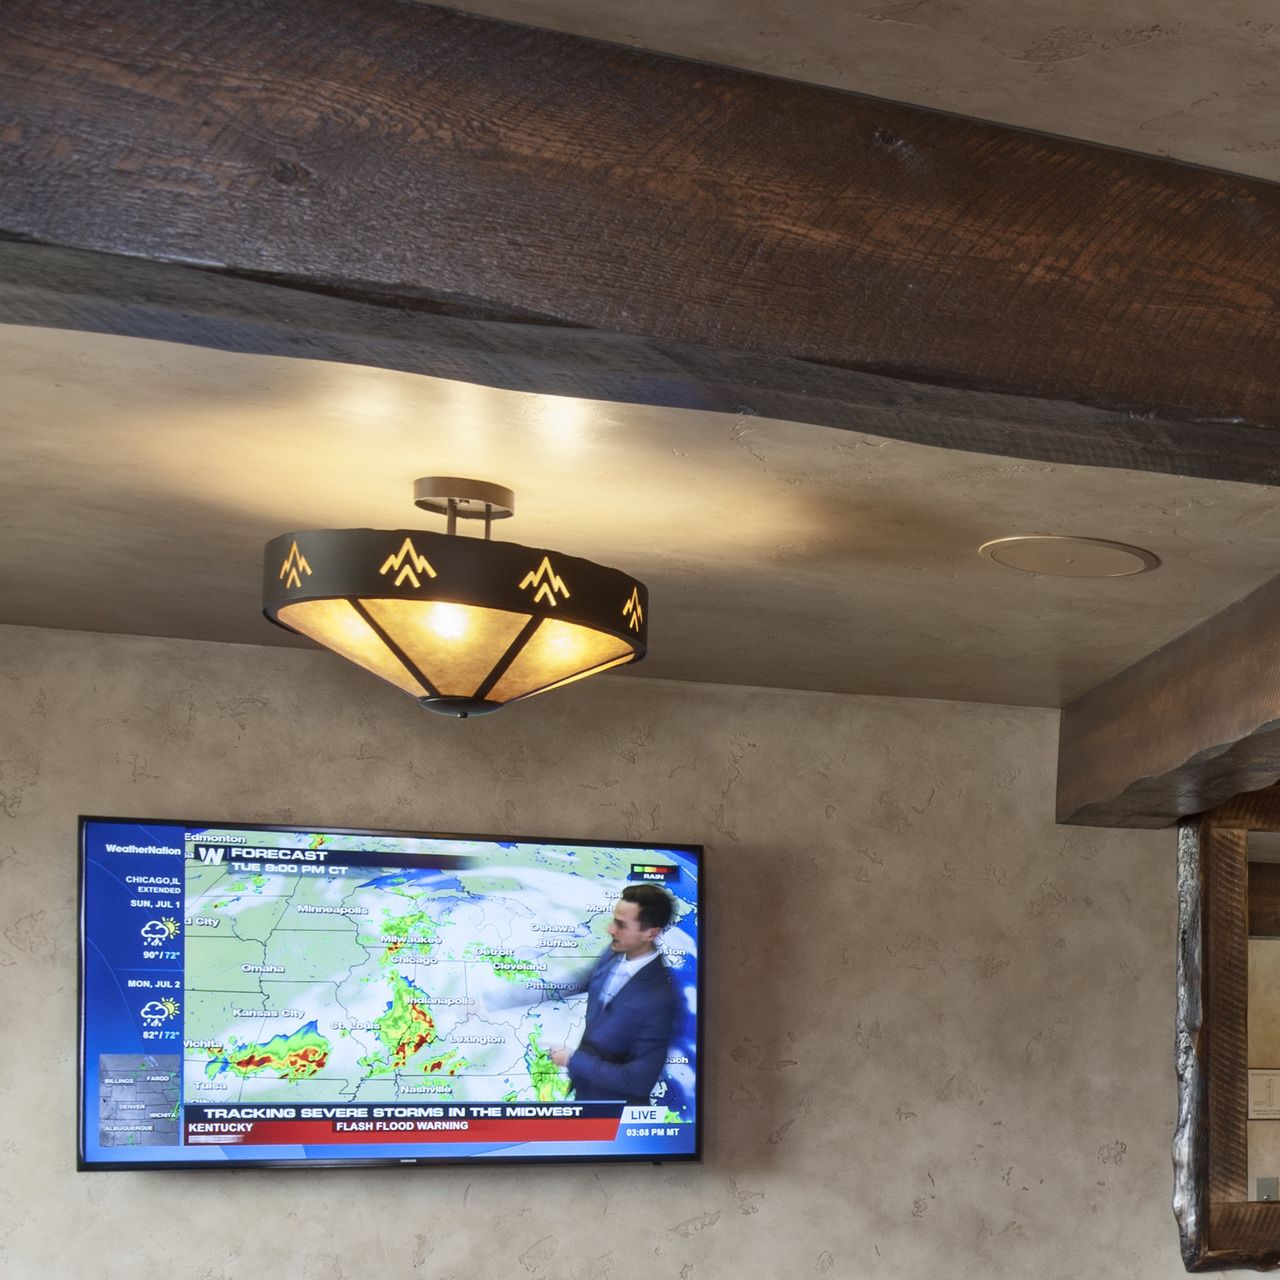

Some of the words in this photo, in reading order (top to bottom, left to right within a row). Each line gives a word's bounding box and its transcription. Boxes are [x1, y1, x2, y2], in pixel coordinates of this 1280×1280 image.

[185, 833, 246, 843] Edmonton
[105, 843, 181, 855] WeatherNation
[231, 847, 328, 861] FORECAST
[231, 862, 261, 872] TUE
[265, 864, 297, 873] 9:00
[301, 865, 325, 874] PM
[328, 866, 348, 875] CT
[138, 886, 181, 894] EXTENDED
[130, 899, 153, 908] SUN,
[155, 900, 173, 908] JUL
[586, 904, 616, 912] Mont
[297, 904, 369, 915] Minneapolis
[195, 918, 219, 927] City
[381, 935, 442, 945] Milwaukee
[539, 939, 578, 948] Buffalo
[475, 947, 514, 956] Detroit
[391, 955, 438, 966] Chicago
[241, 964, 285, 973] Omaha
[493, 962, 547, 971] Cleveland
[128, 980, 152, 988] MON,
[155, 980, 173, 988] JUL
[233, 1008, 278, 1017] Kansas
[281, 1008, 305, 1019] City
[193, 1081, 227, 1090] Tulsa
[400, 1085, 452, 1093] Nashville
[204, 1108, 296, 1119] TRACKING
[300, 1108, 369, 1118] SEVERE
[373, 1107, 444, 1118] STORMS
[448, 1107, 465, 1117] IN
[470, 1107, 501, 1116] THE
[506, 1106, 583, 1117] MIDWEST
[631, 1110, 657, 1120] LIVE
[188, 1123, 253, 1132] KENTUCKY
[336, 1122, 373, 1131] FLASH
[376, 1121, 414, 1130] FLOOD
[417, 1121, 468, 1130] WARNING
[651, 1128, 665, 1136] PM
[666, 1128, 680, 1136] MT
